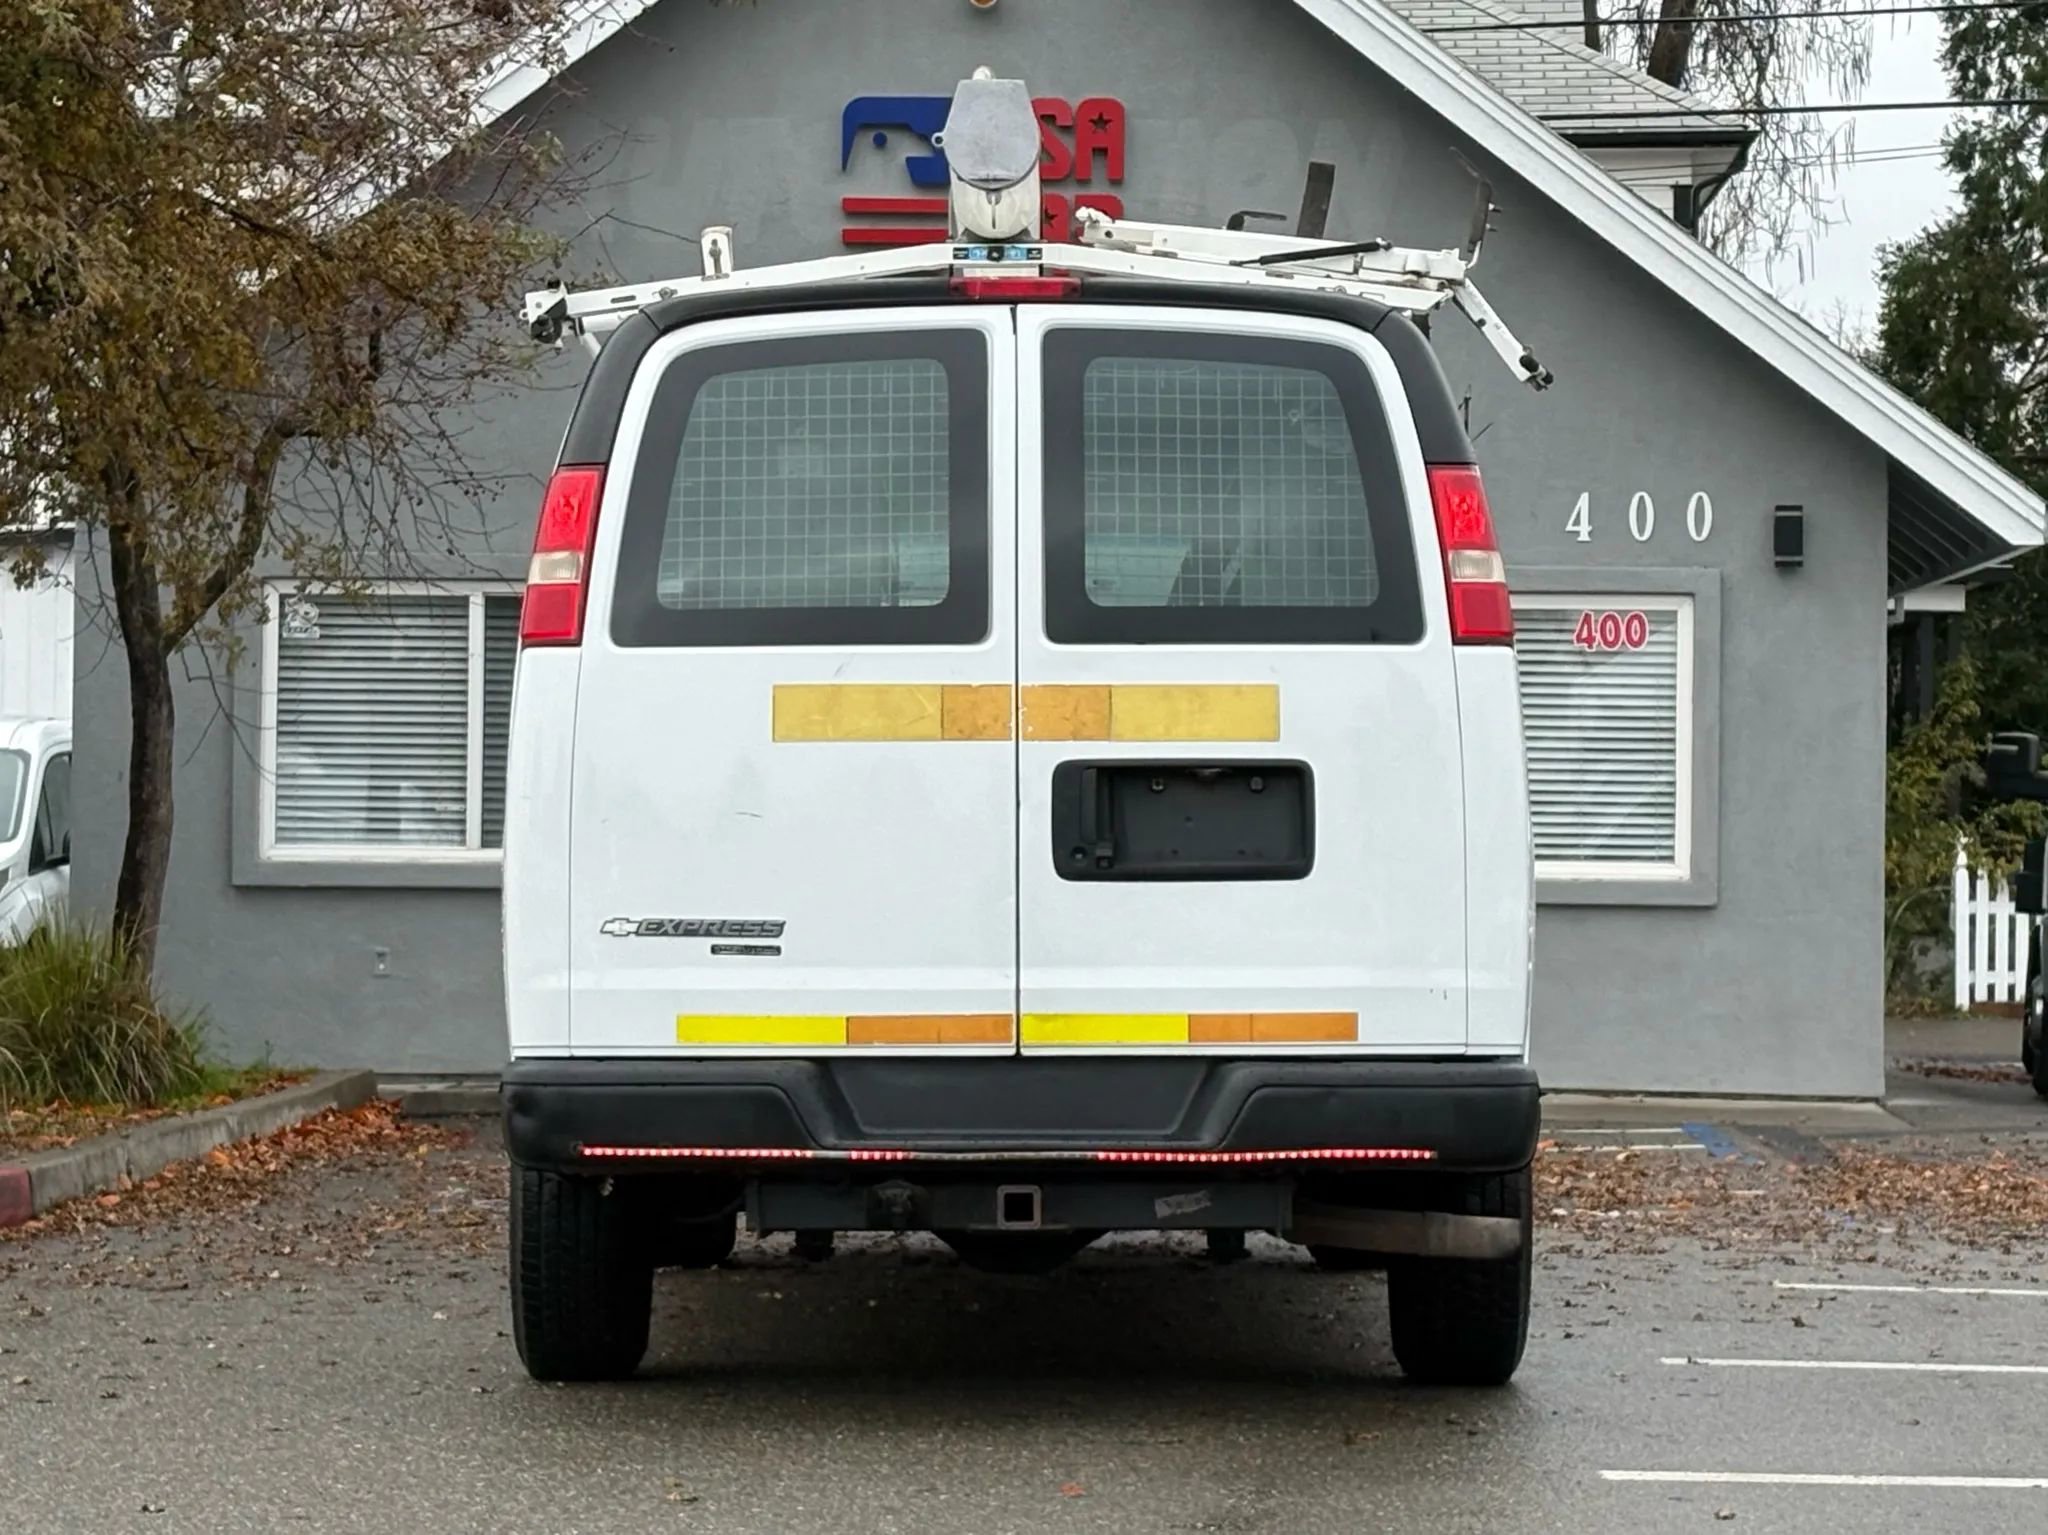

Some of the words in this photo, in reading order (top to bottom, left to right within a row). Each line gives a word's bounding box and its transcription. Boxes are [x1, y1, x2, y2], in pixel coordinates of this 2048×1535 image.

[1565, 491, 1713, 542] 400
[1573, 610, 1649, 652] 400
[637, 918, 785, 937] EXPRESS
